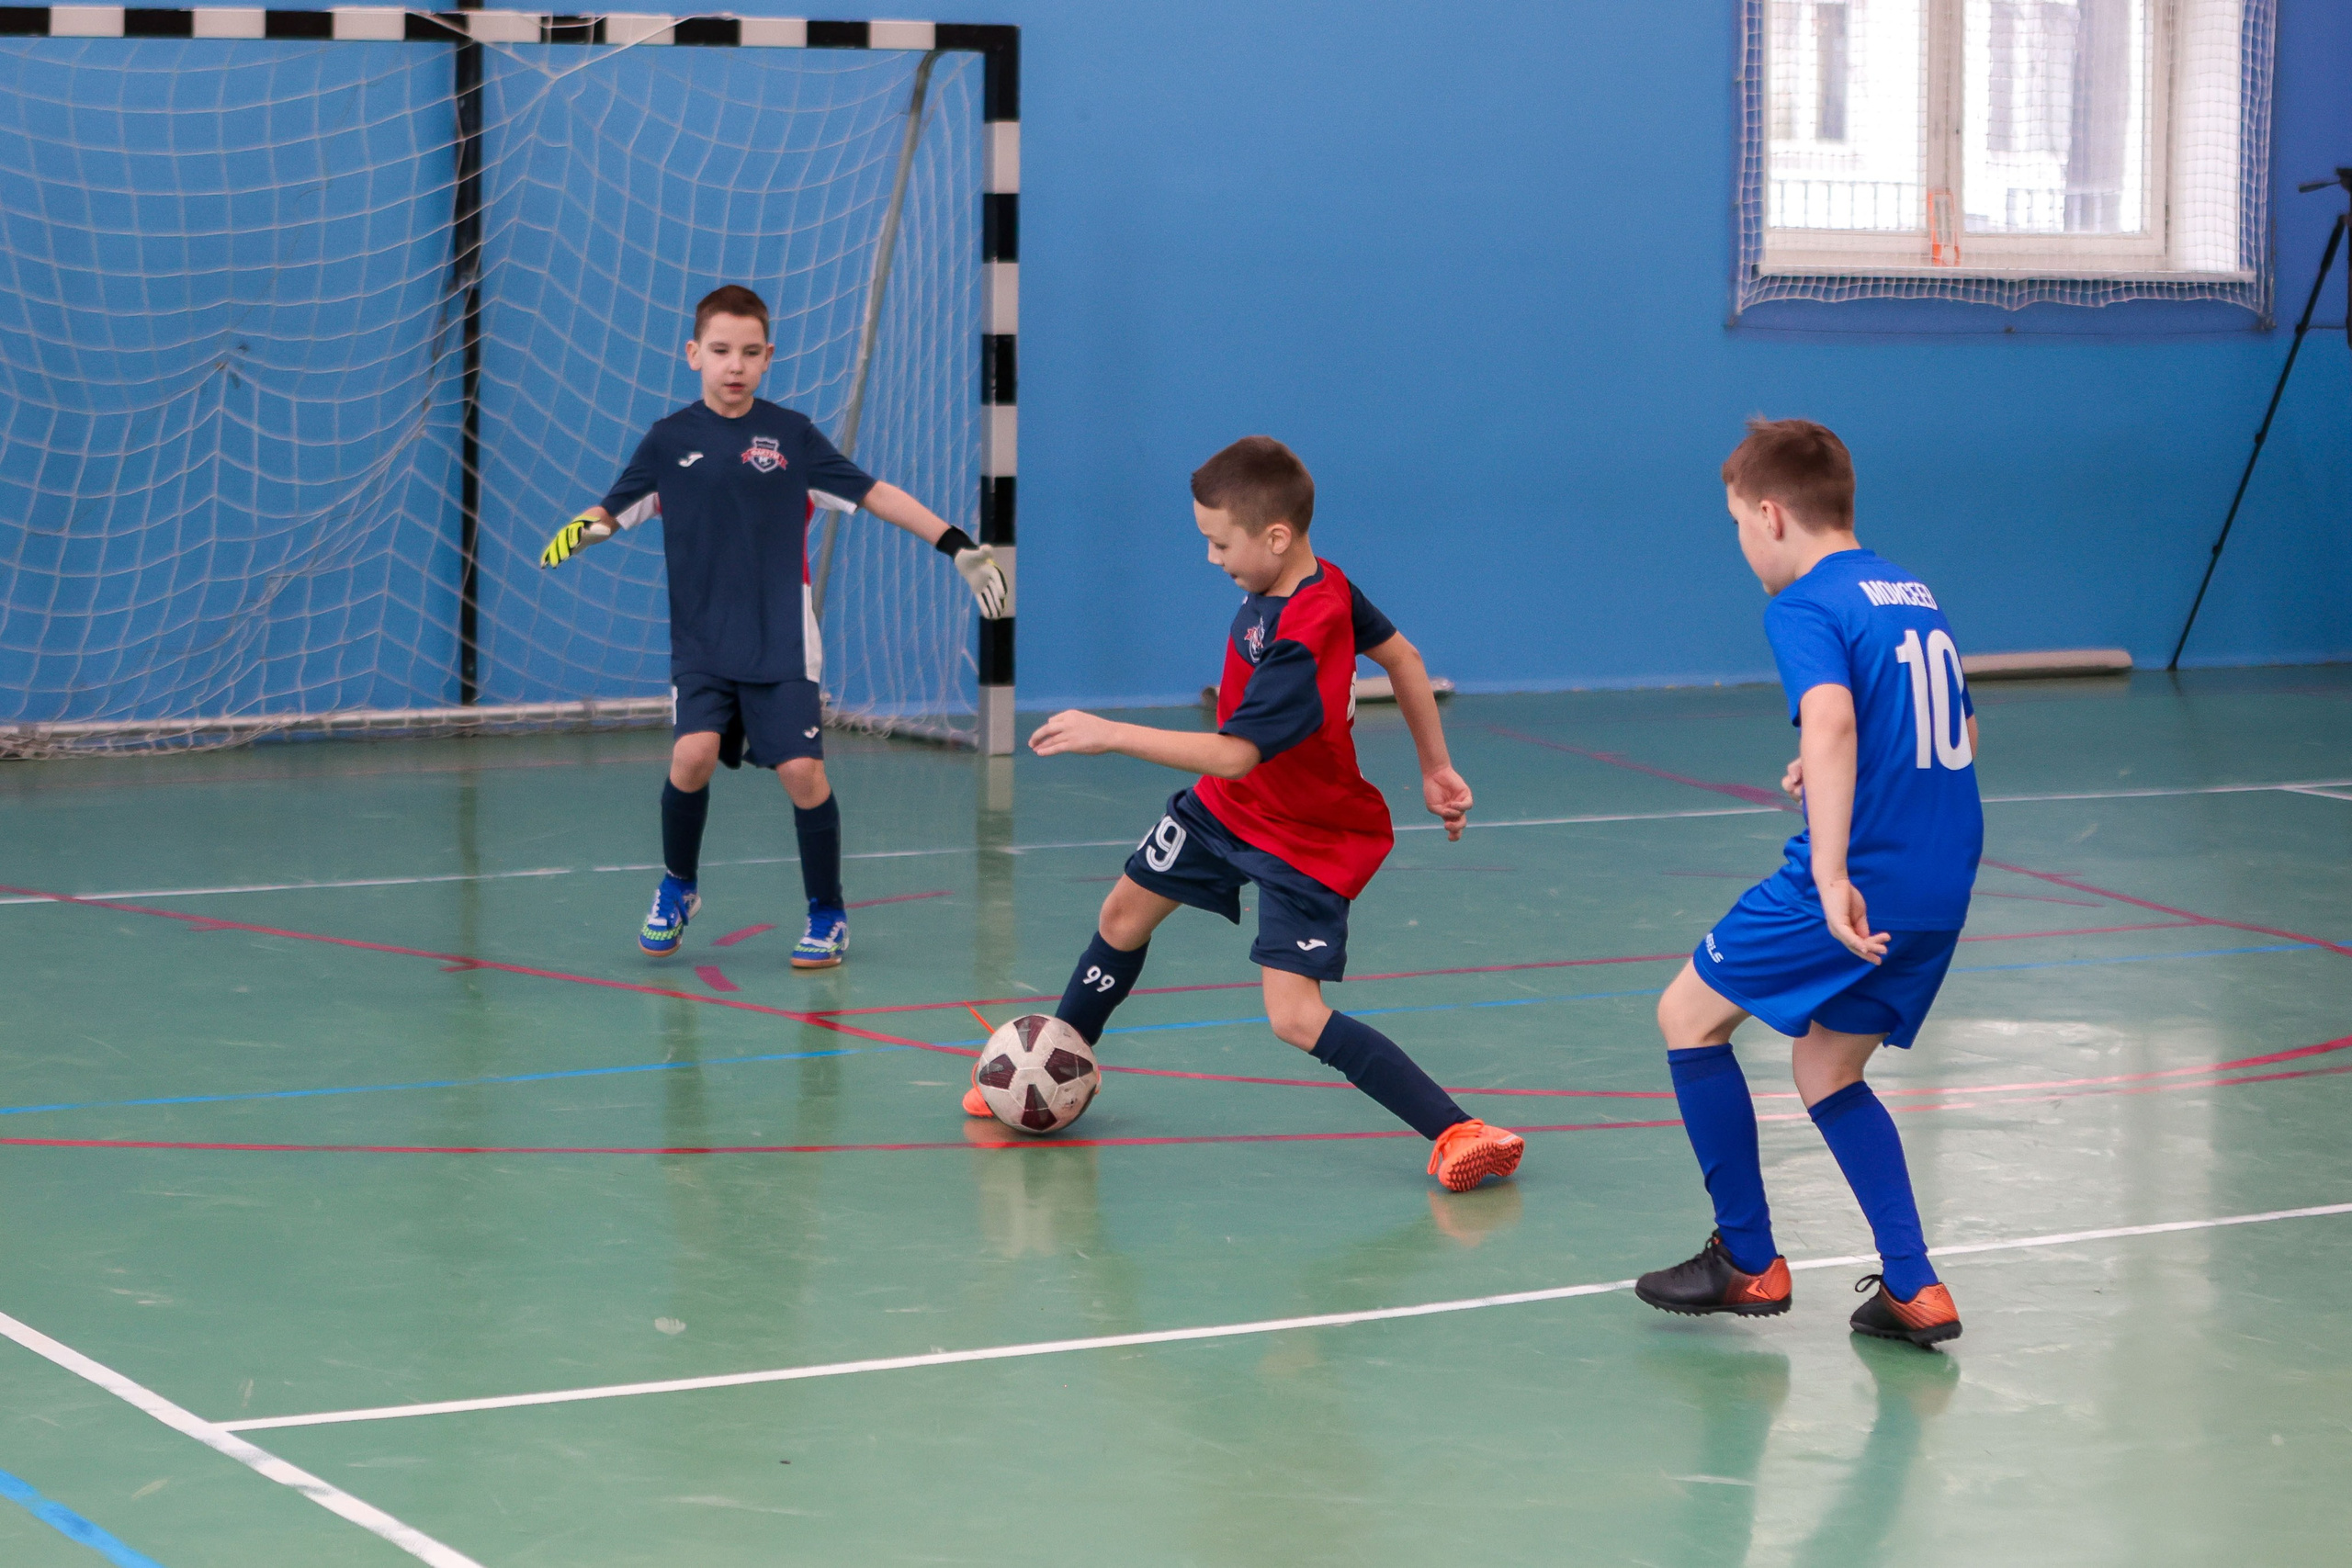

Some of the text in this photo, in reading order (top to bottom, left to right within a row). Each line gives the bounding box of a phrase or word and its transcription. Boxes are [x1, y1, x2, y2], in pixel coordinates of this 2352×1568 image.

[1858, 580, 1939, 611] МОИСЕЕВ
[1894, 628, 1973, 771] 10
[1136, 814, 1187, 873] 9
[1082, 964, 1116, 993] 99
